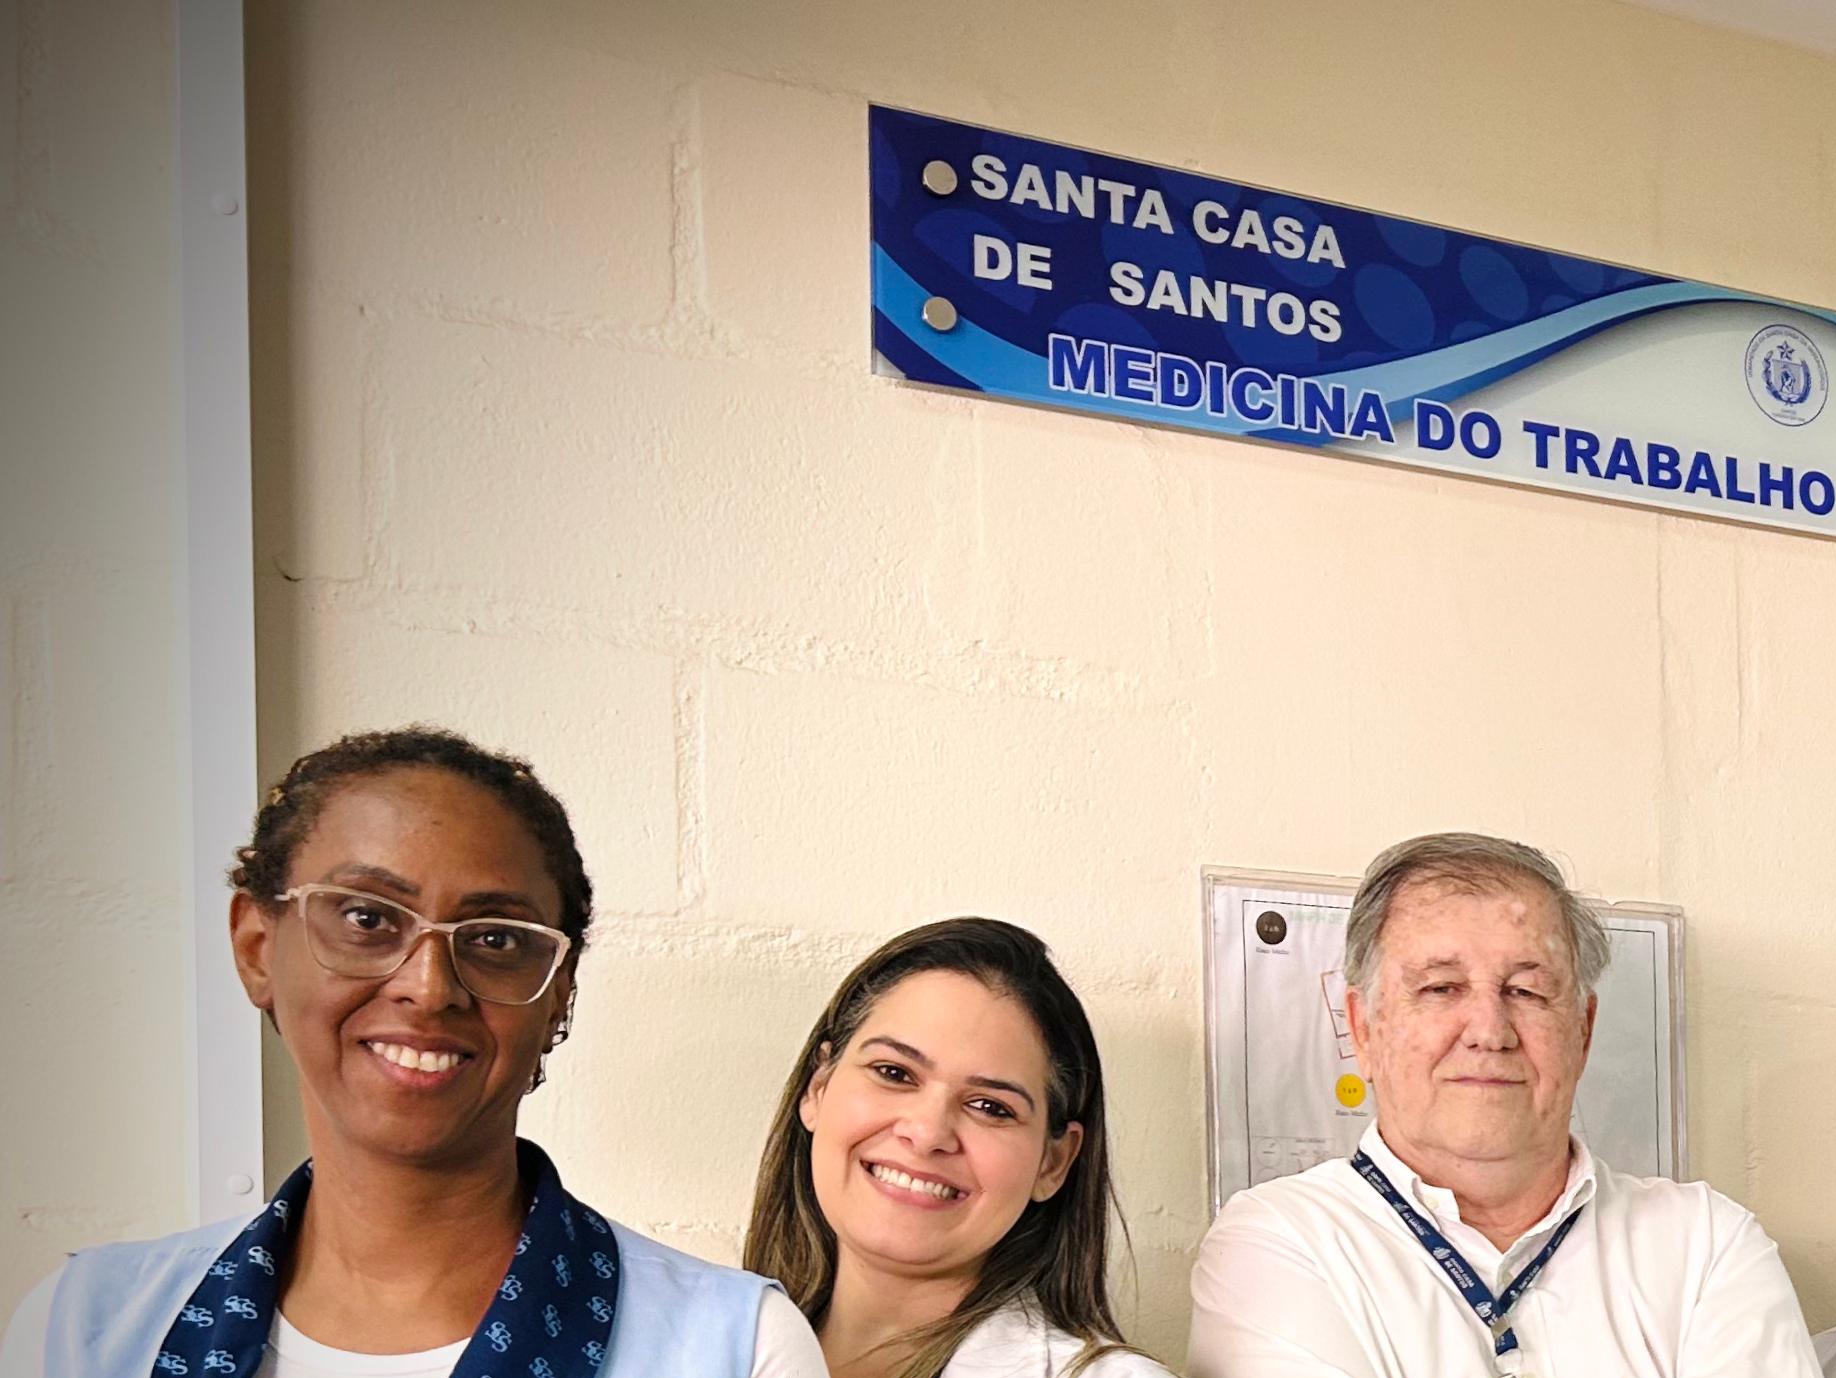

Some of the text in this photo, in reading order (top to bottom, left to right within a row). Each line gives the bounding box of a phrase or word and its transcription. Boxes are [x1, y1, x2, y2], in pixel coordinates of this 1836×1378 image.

[970, 154, 1346, 269] SANTA CASA
[974, 234, 1342, 342] DE SANTOS
[1048, 334, 1836, 516] MEDICINA DO TRABALHO
